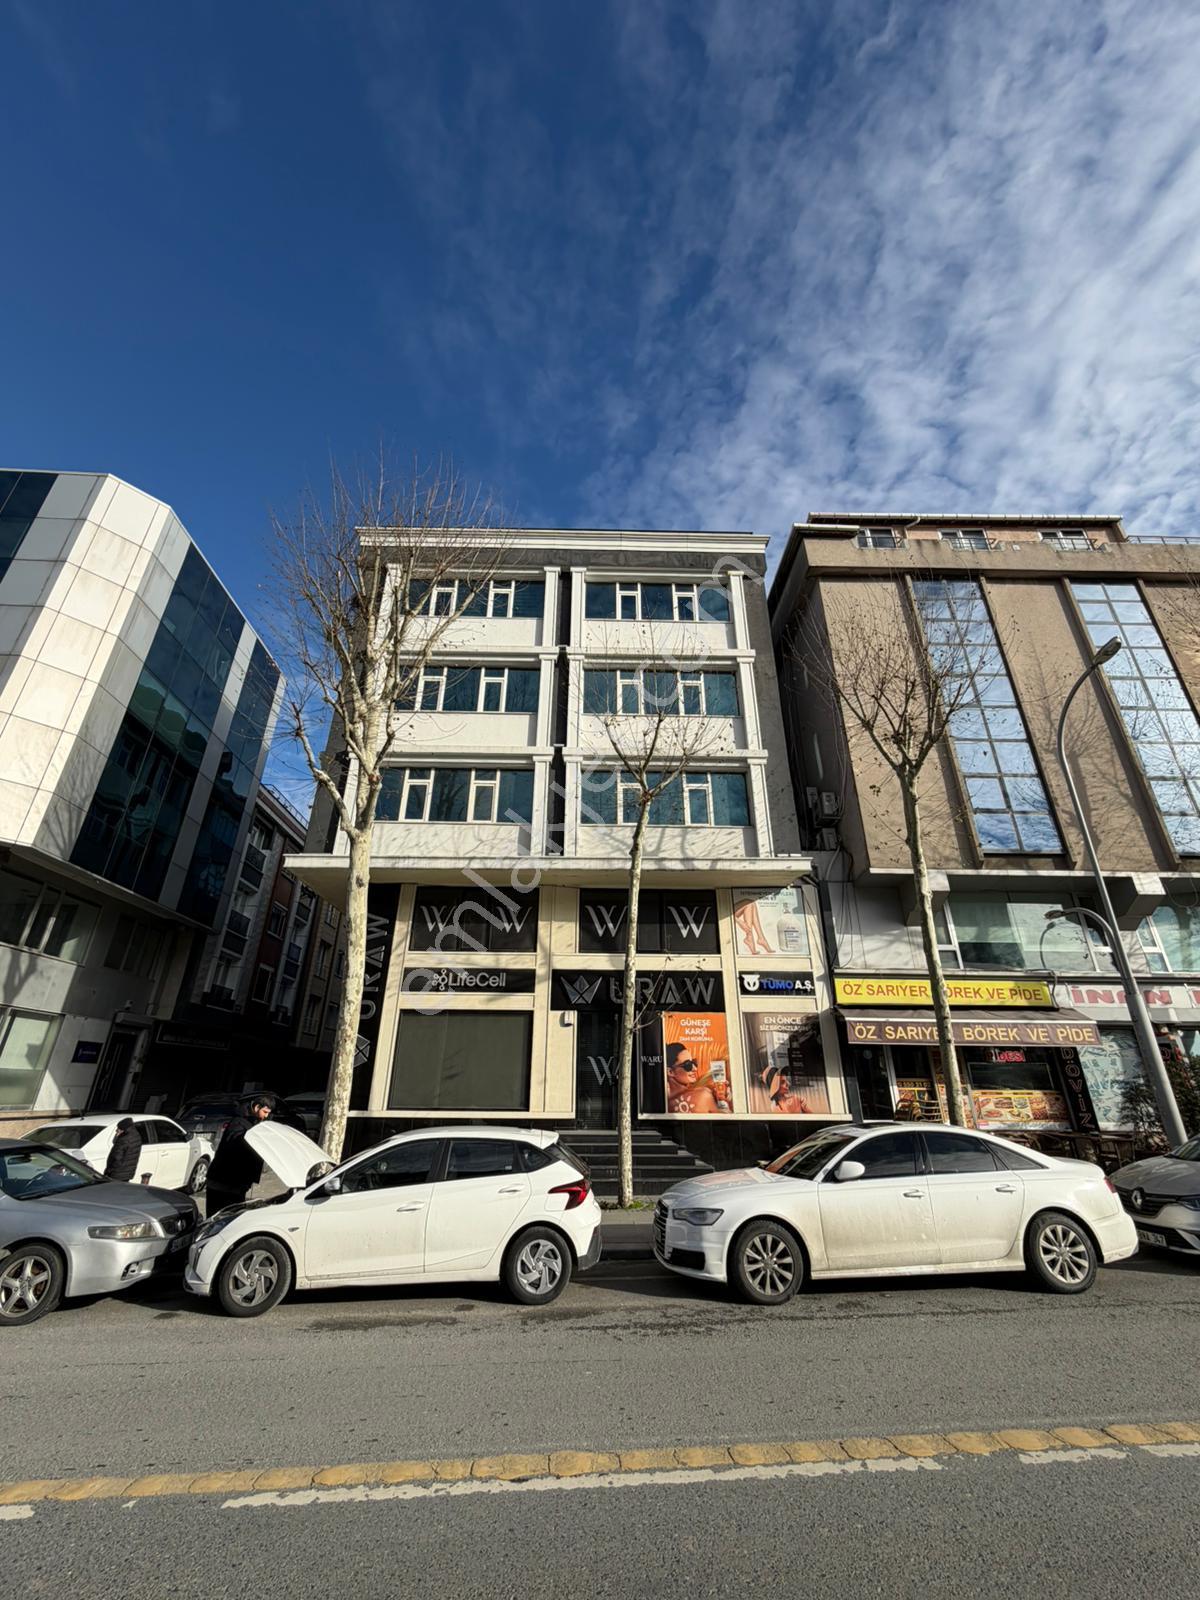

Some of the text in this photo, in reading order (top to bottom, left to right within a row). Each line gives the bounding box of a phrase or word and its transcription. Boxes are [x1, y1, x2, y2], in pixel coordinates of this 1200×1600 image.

[584, 905, 629, 937] W
[666, 906, 711, 938] W
[448, 972, 507, 987] LifeCell
[760, 978, 794, 989] TÜMO
[842, 983, 1044, 1001] ÖZ SARIYER ÖREK VE PİDE
[680, 1018, 711, 1027] GÜNEŞE
[764, 1015, 802, 1025] EN ÖNCE
[854, 1023, 1095, 1042] ÖZ SARIYE BÖREK VE PİDE
[1061, 1047, 1096, 1129] DÖVİZ
